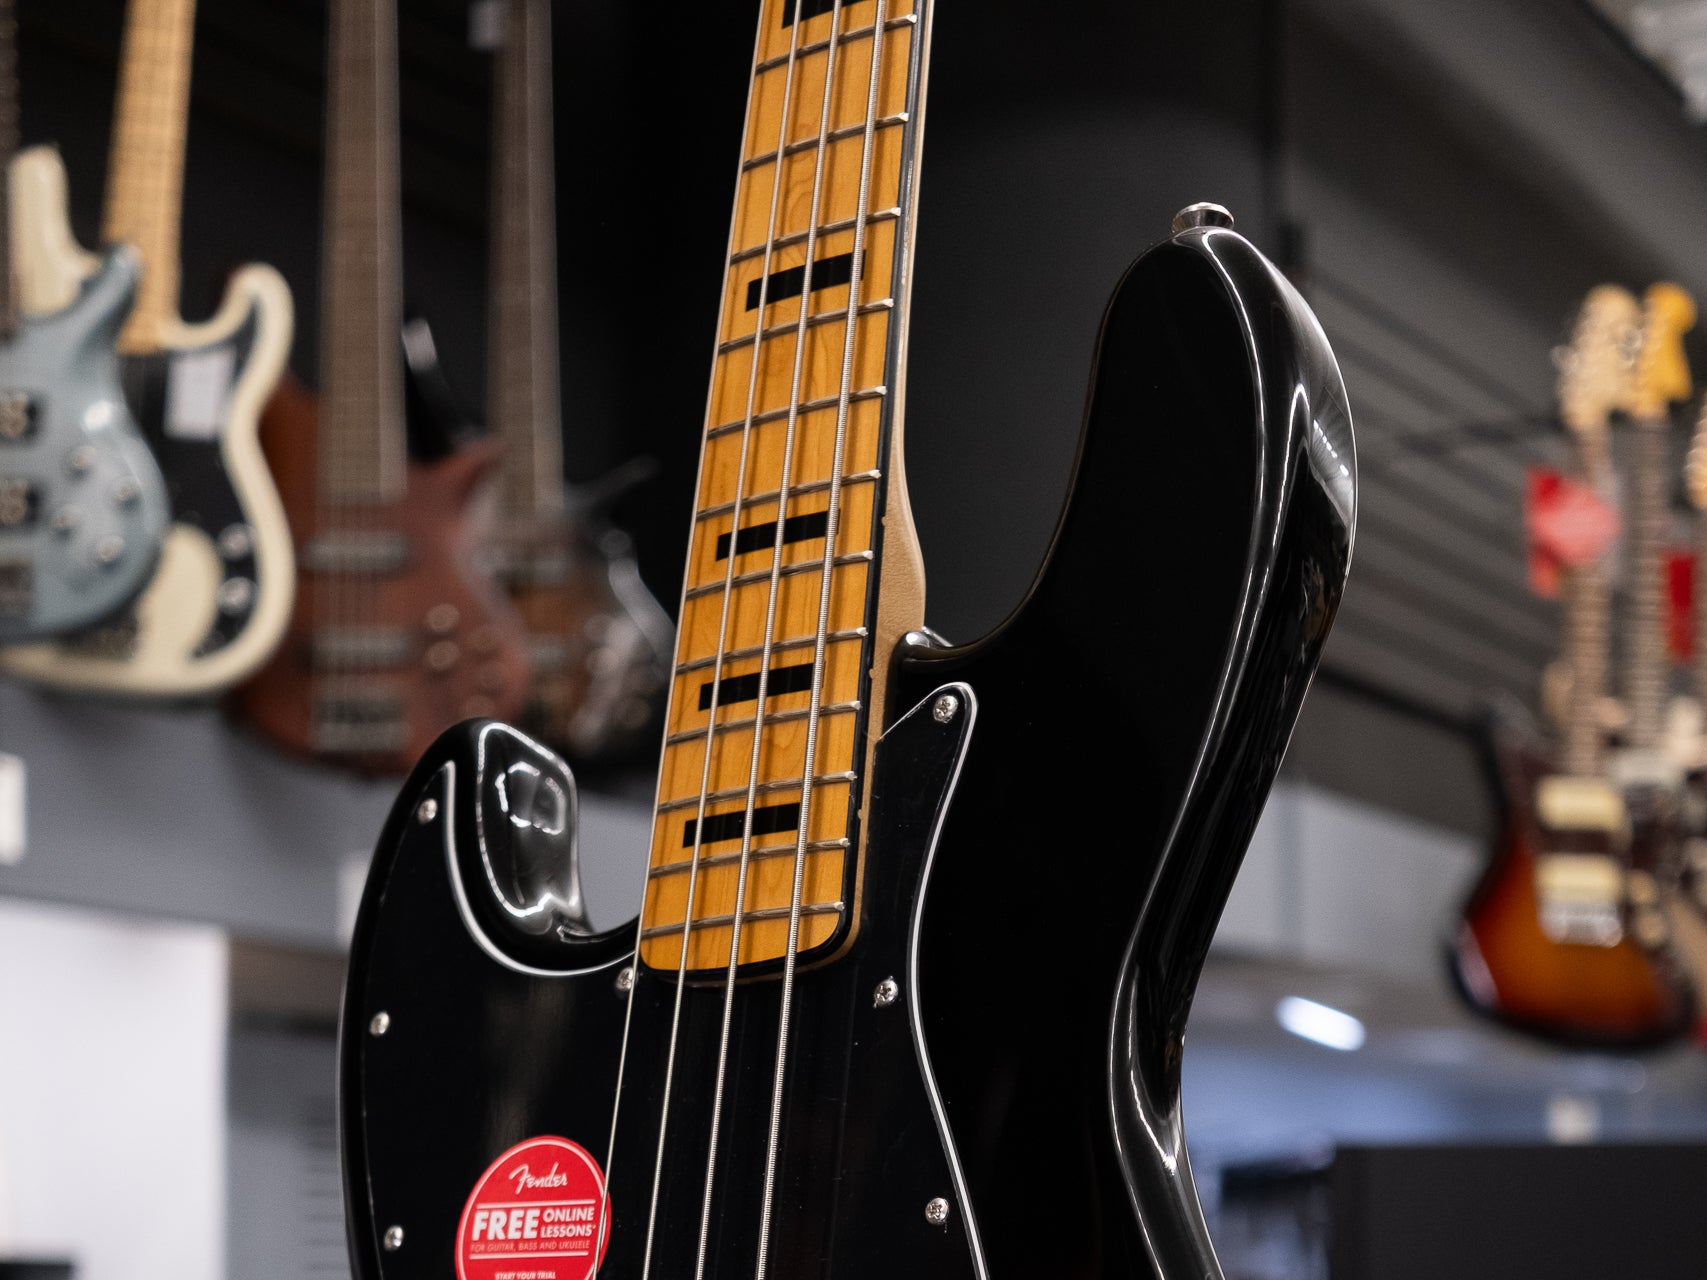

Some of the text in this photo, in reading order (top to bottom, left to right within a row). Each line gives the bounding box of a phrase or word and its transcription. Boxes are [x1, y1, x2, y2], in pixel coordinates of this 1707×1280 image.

[509, 1162, 568, 1195] Fender
[472, 1207, 595, 1241] FREE ONLINE
[470, 1243, 486, 1253] FOR
[518, 1242, 538, 1251] BASS
[540, 1241, 557, 1250] AND
[558, 1240, 590, 1250] UKULELE
[495, 1271, 556, 1280] START YOUR TRIAL
